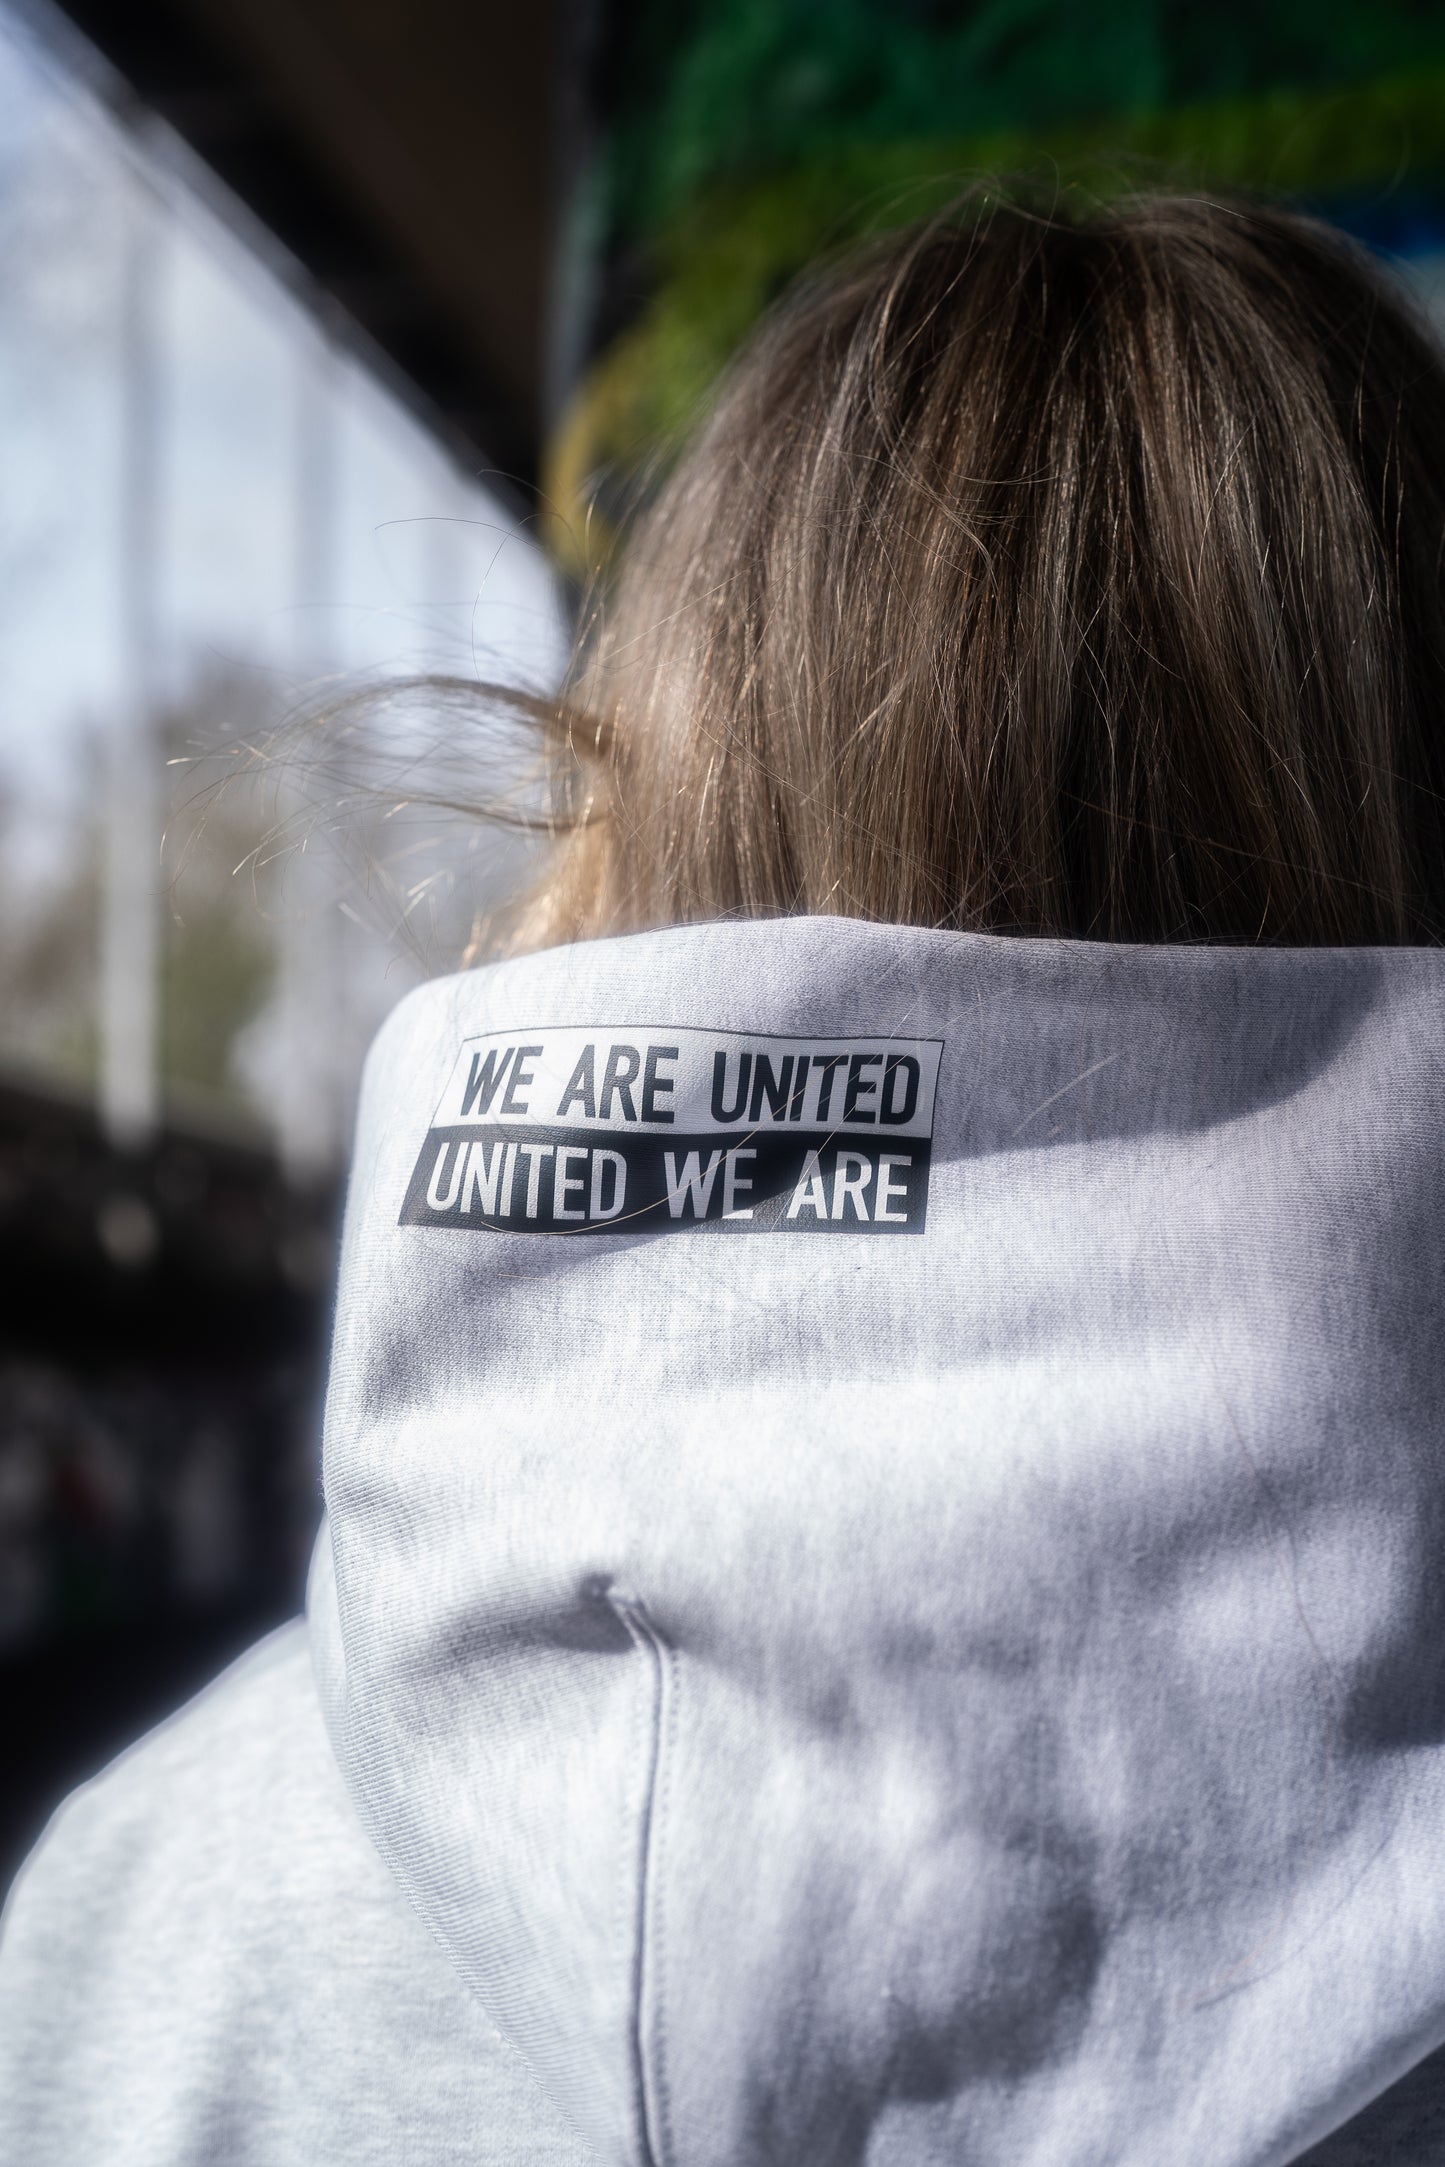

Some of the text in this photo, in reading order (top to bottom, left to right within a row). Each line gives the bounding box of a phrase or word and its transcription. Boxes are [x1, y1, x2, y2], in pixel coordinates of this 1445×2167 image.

[460, 1044, 921, 1126] WE ARE UNITED
[426, 1141, 913, 1222] UNITED WE ARE
